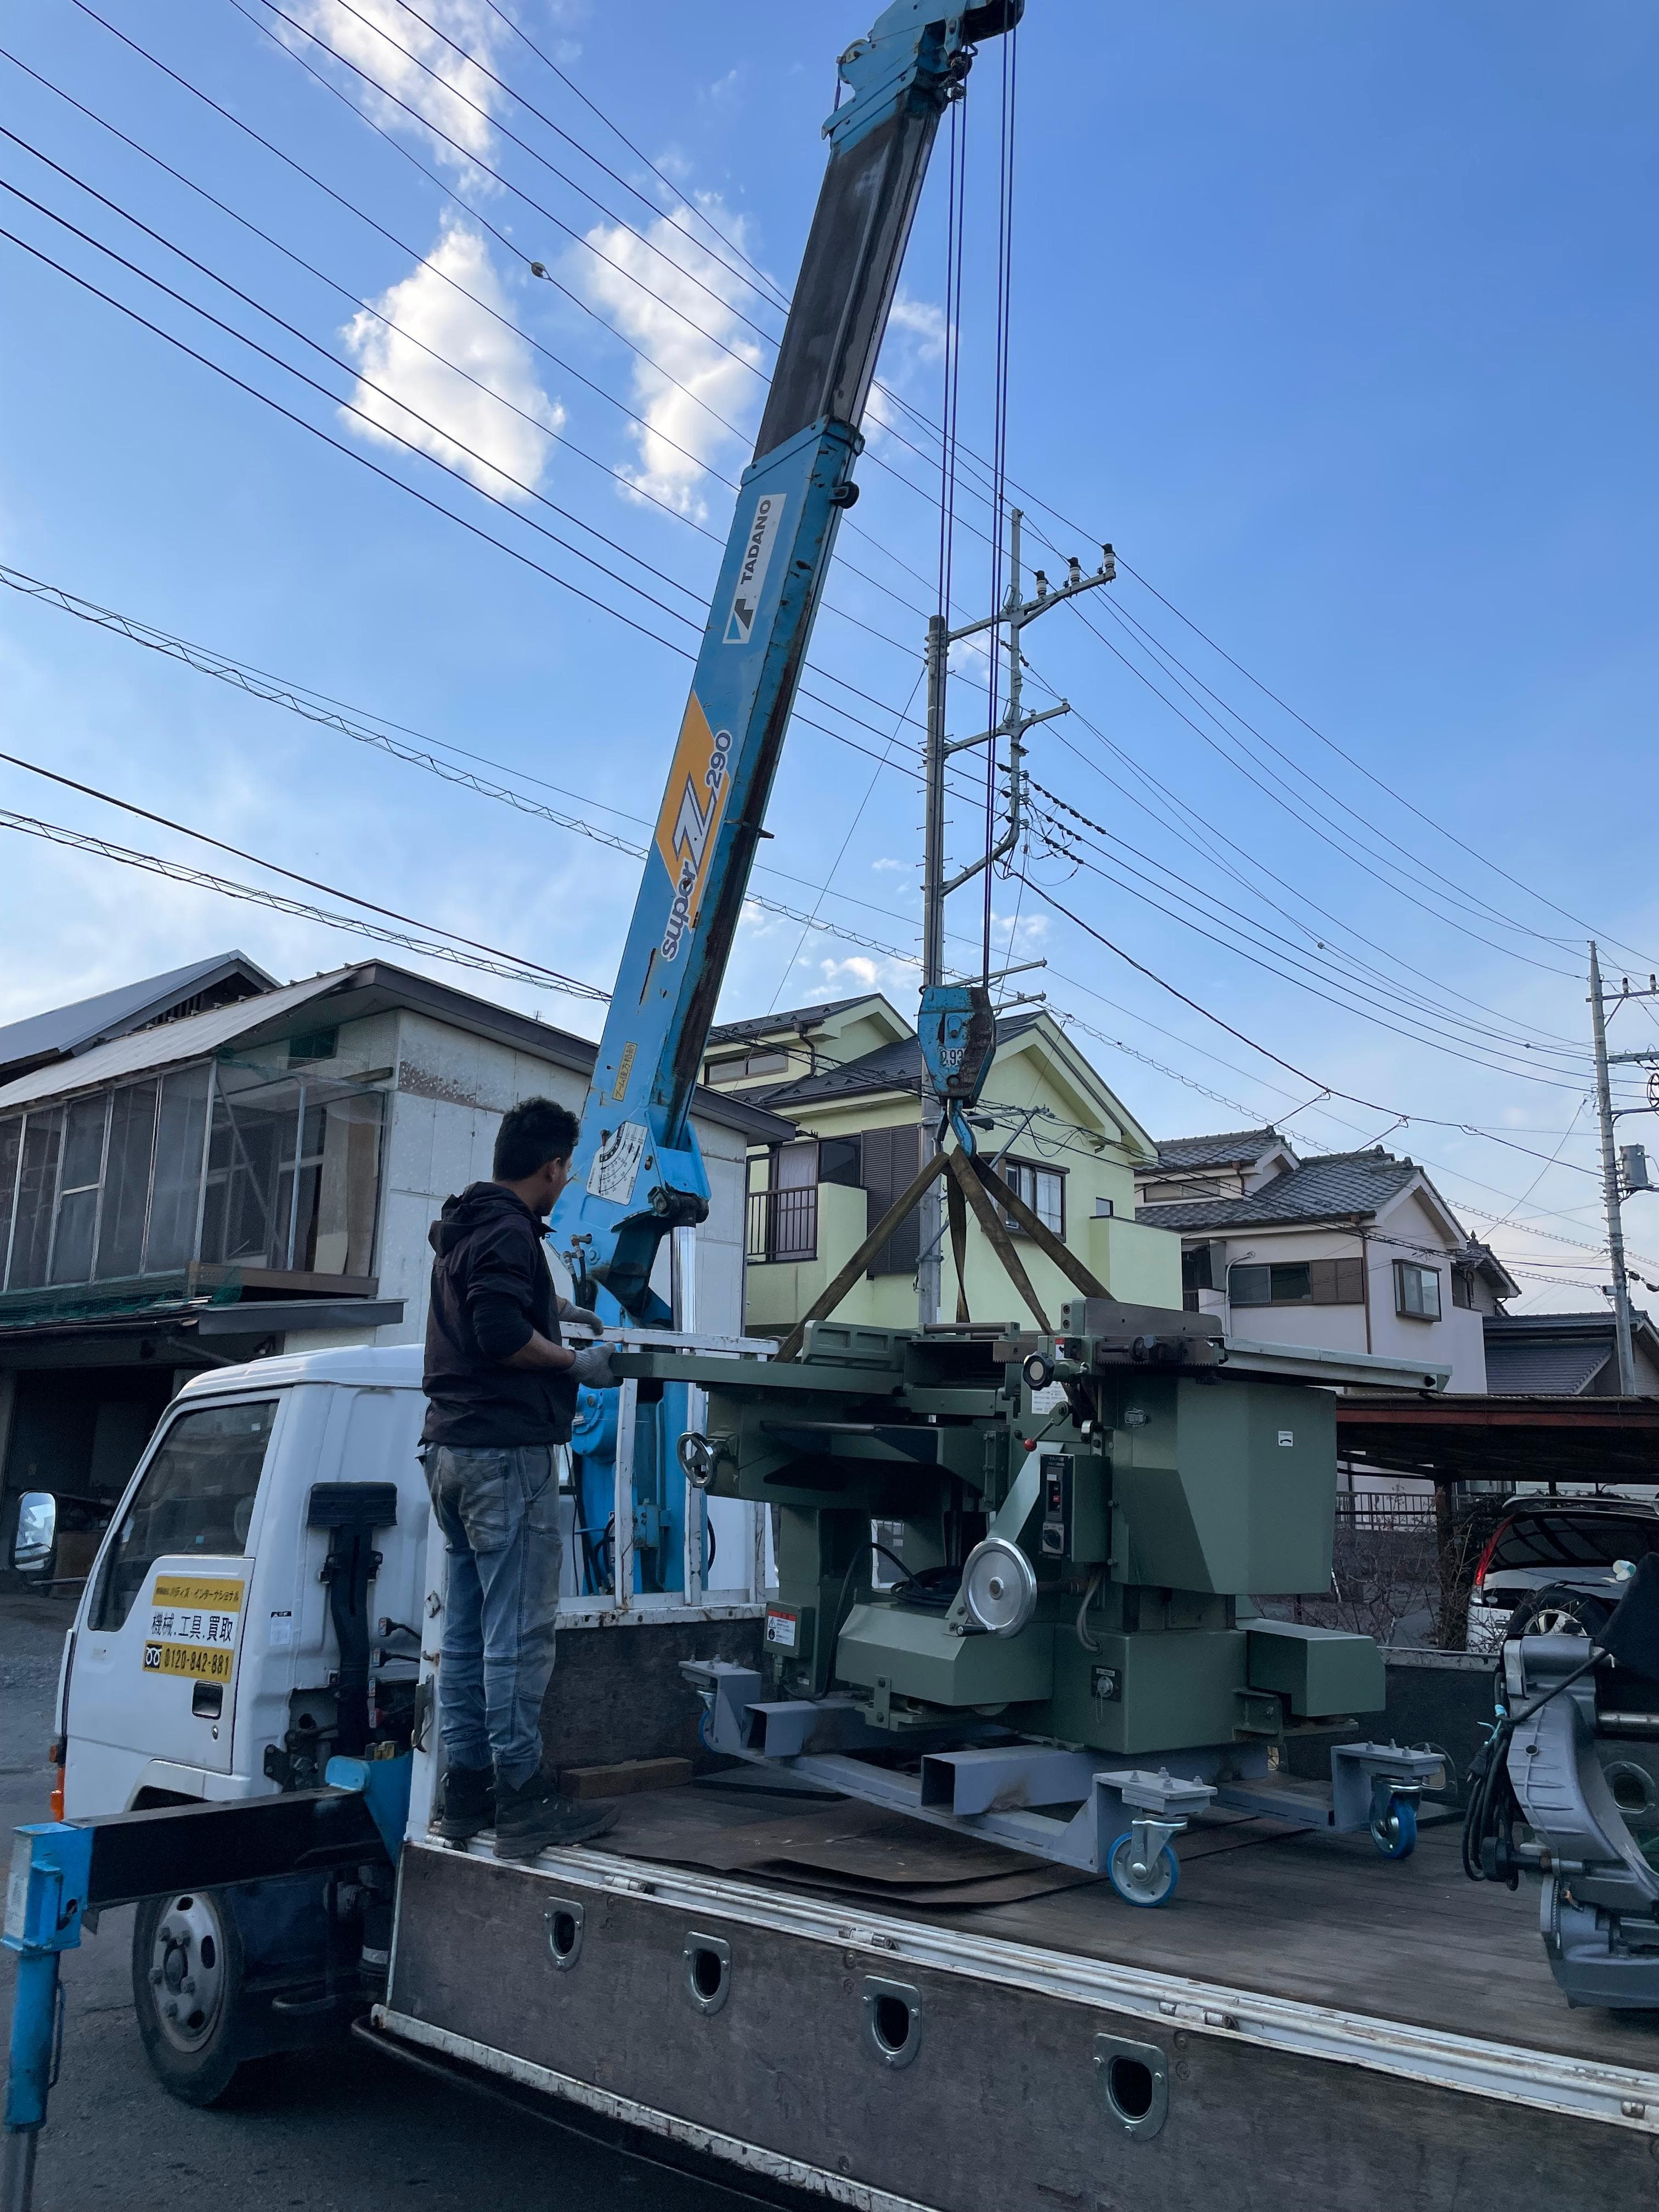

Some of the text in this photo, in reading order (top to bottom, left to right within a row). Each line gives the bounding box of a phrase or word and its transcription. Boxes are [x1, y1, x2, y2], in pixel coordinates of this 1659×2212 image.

[741, 500, 771, 585] TADANO
[662, 860, 697, 960] super
[707, 731, 731, 789] 290
